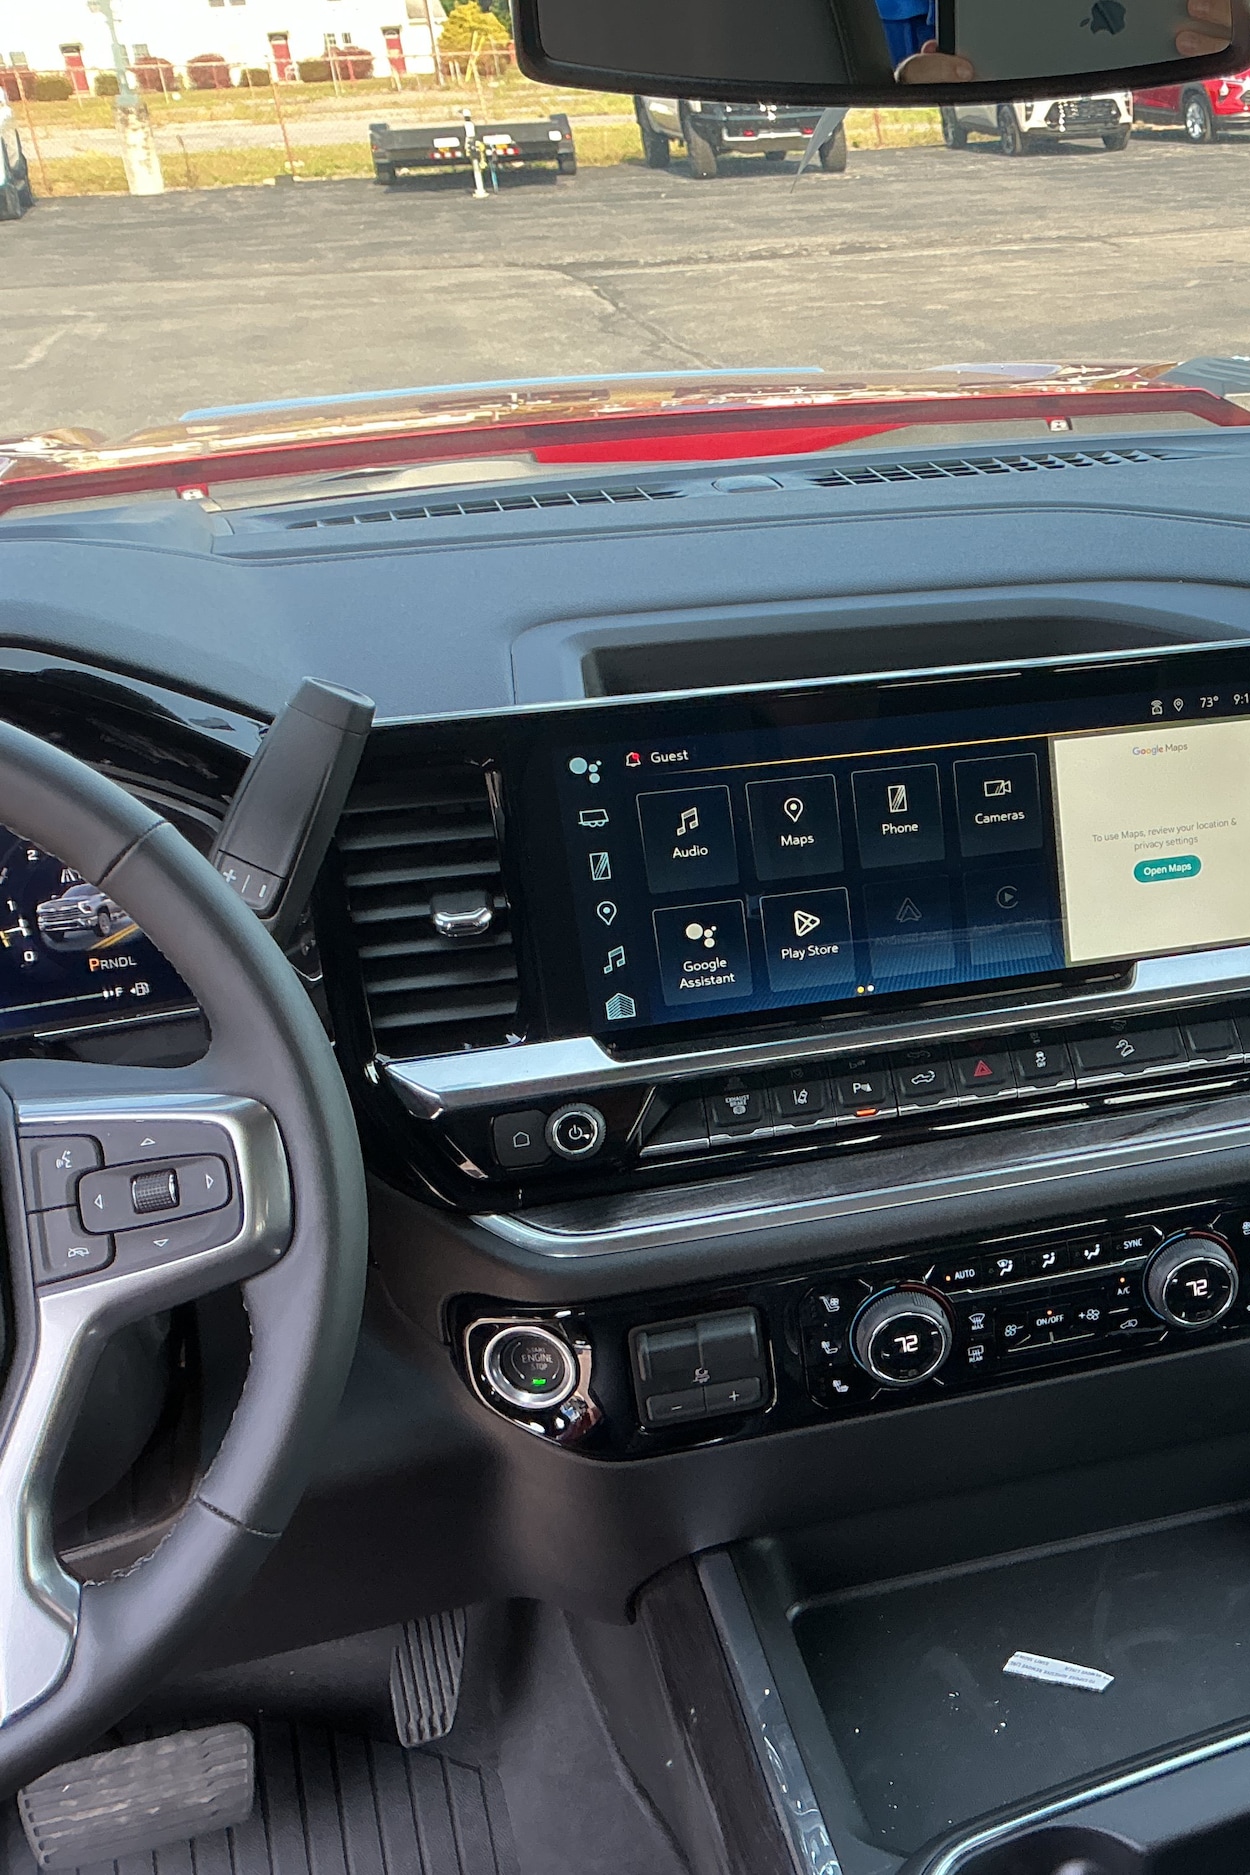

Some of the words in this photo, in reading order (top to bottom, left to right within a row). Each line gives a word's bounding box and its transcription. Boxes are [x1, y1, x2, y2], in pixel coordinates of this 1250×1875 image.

[650, 749, 689, 764] Guest
[1132, 745, 1164, 757] Google
[1165, 742, 1188, 754] Maps
[975, 809, 1025, 825] Cameras
[882, 821, 919, 835] Phone
[1092, 833, 1101, 843] To
[1102, 833, 1119, 842] use
[1147, 826, 1174, 839] review
[1176, 823, 1195, 836] your
[1196, 818, 1229, 831] location
[780, 833, 814, 847] Maps
[1134, 839, 1164, 852] privacy
[1166, 835, 1198, 849] settings
[27, 849, 38, 861] 2
[672, 845, 708, 859] Audio
[1143, 865, 1166, 879] Open
[1168, 862, 1192, 876] Maps
[7, 900, 15, 912] 1
[23, 950, 34, 963] 0
[781, 946, 805, 961] Play
[807, 941, 839, 957] Store
[89, 956, 137, 972] PRNDL
[683, 957, 727, 974] Google
[679, 971, 735, 989] Assistant
[1123, 1238, 1143, 1249] SYNC
[954, 1268, 976, 1281] AUTO
[1117, 1285, 1131, 1296] A/C
[1186, 1279, 1208, 1297] 72
[1036, 1314, 1064, 1327] ON/OFF
[894, 1334, 918, 1353] 72
[521, 1353, 553, 1364] ENGINE
